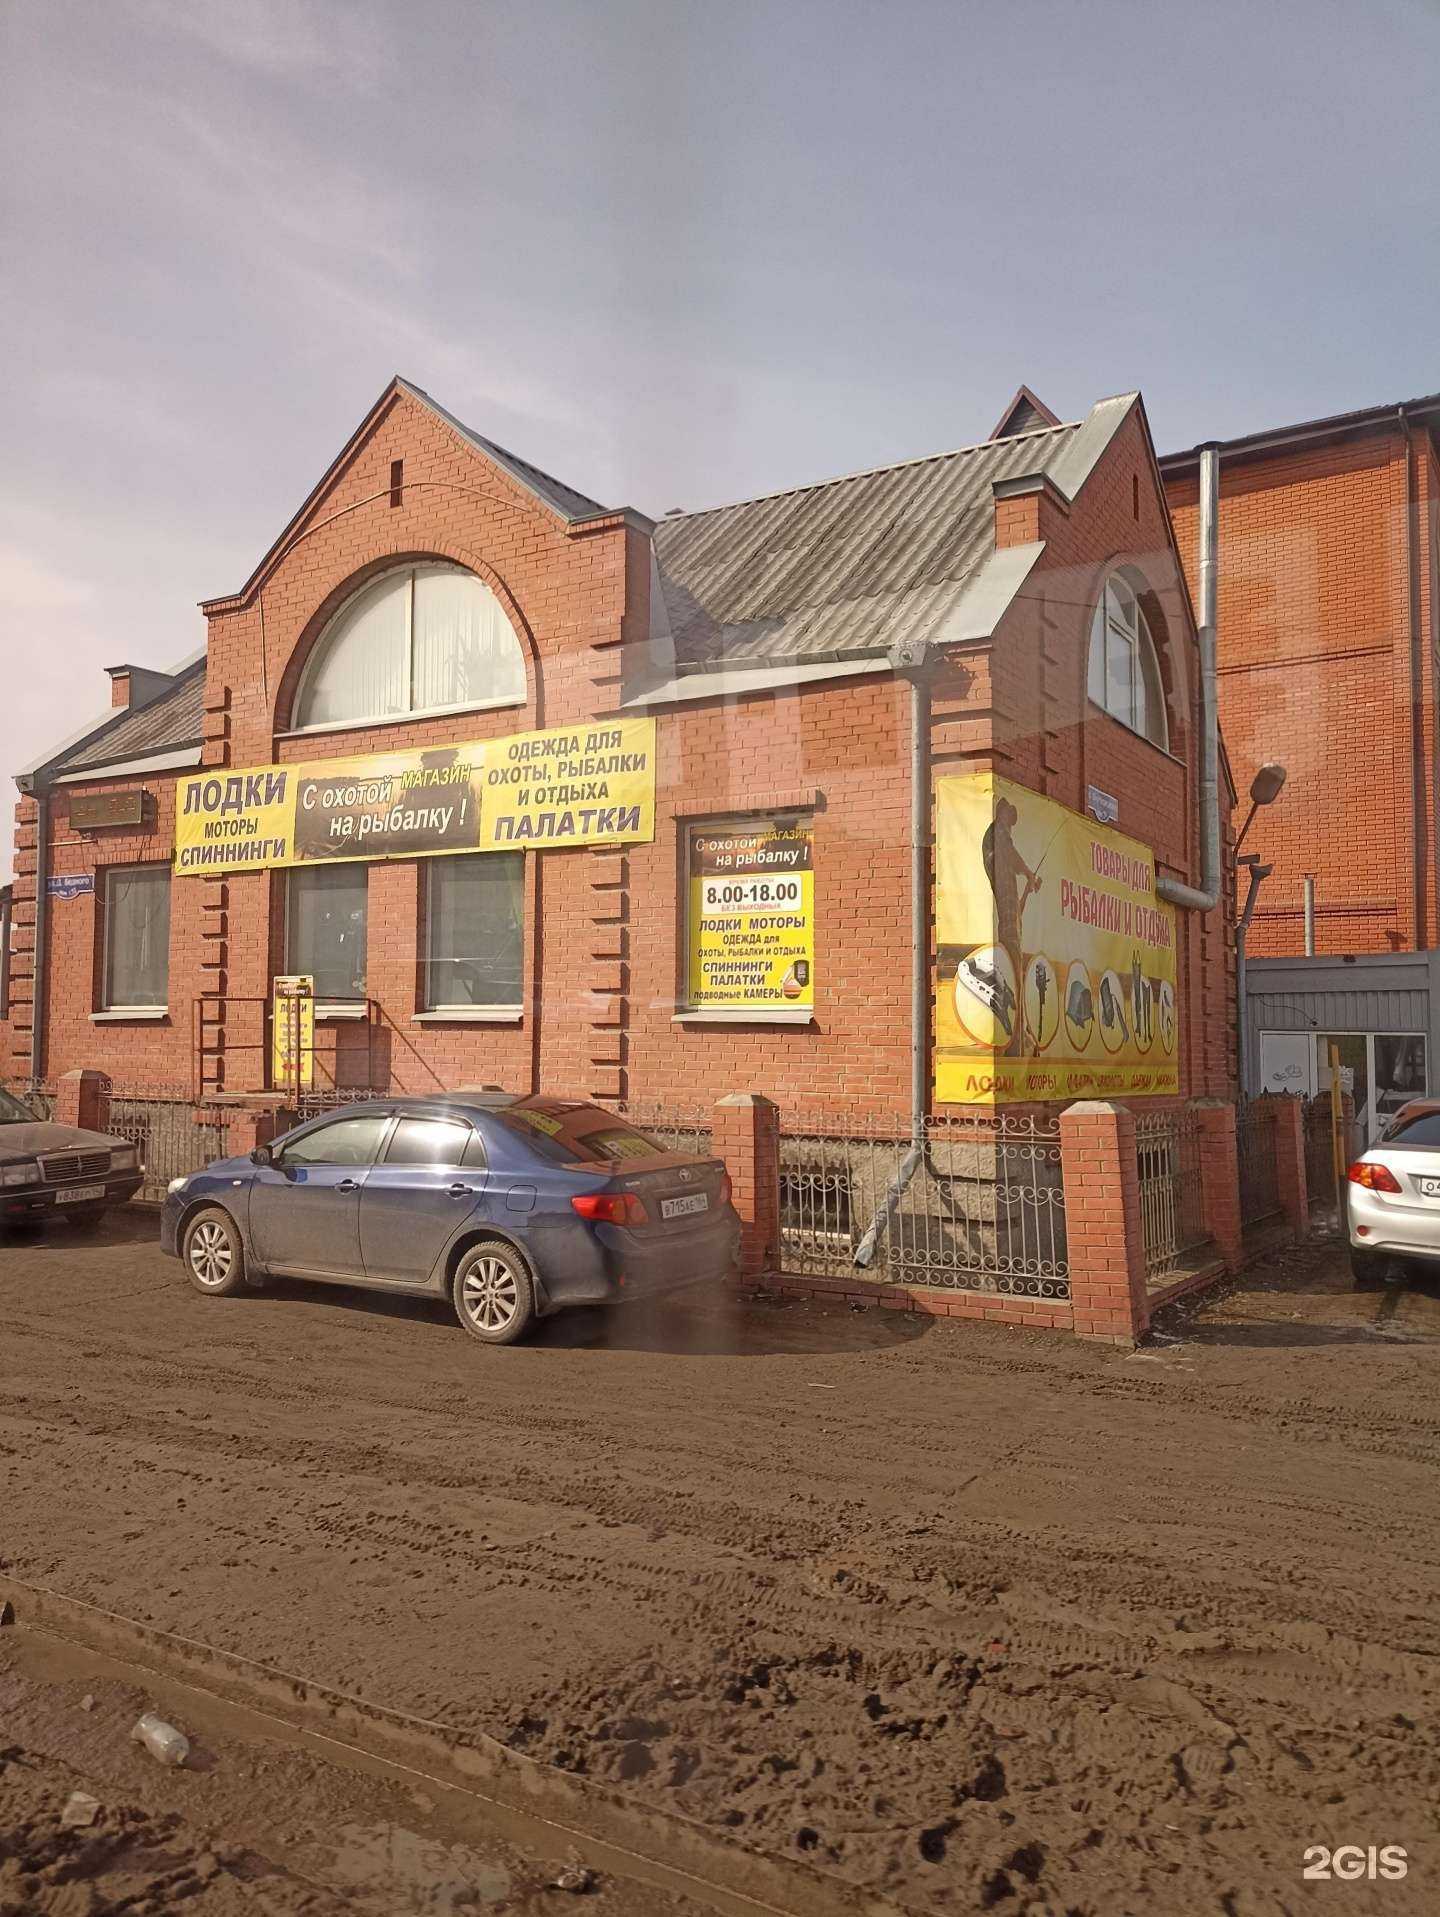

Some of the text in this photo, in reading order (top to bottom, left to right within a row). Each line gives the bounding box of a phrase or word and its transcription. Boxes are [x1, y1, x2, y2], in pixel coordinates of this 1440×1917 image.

[508, 730, 623, 762] ОДЕЖДА ДЛЯ
[400, 763, 472, 790] МАГАЗИН
[488, 753, 646, 786] ОХОТЫ, РЫБАЛКИ
[183, 771, 288, 817] ЛОДКИ
[302, 775, 394, 810] С охотой
[517, 781, 609, 806] И ОТДЫХА
[204, 817, 259, 839] МОТОРЫ
[329, 815, 354, 837] на
[358, 804, 454, 840] рыбалку
[494, 805, 641, 841] ПАЛАТКИ
[180, 838, 286, 867] СПИННИНГИ
[695, 836, 757, 852] С охотой
[715, 855, 732, 867] на
[735, 849, 799, 868] рыбалку
[1090, 841, 1151, 893] ТОВАРЫ ДЛЯ
[707, 882, 798, 904] 8.00-18.00
[721, 904, 736, 912] БЕЗ
[1061, 878, 1172, 948] РЫБАЛКИ И ОТДЫХА
[699, 917, 806, 933] ЛОДКИ МОТОРЫ
[723, 934, 780, 946] ОДЕЖДА для
[698, 946, 807, 958] ОХОТЫ, РЫБАЛКИ И ОТДЫХА
[703, 961, 773, 973] СПИННИНГИ
[710, 974, 765, 986] ПАЛАТКИ
[693, 988, 783, 1000] подводные КАМЕРЫ
